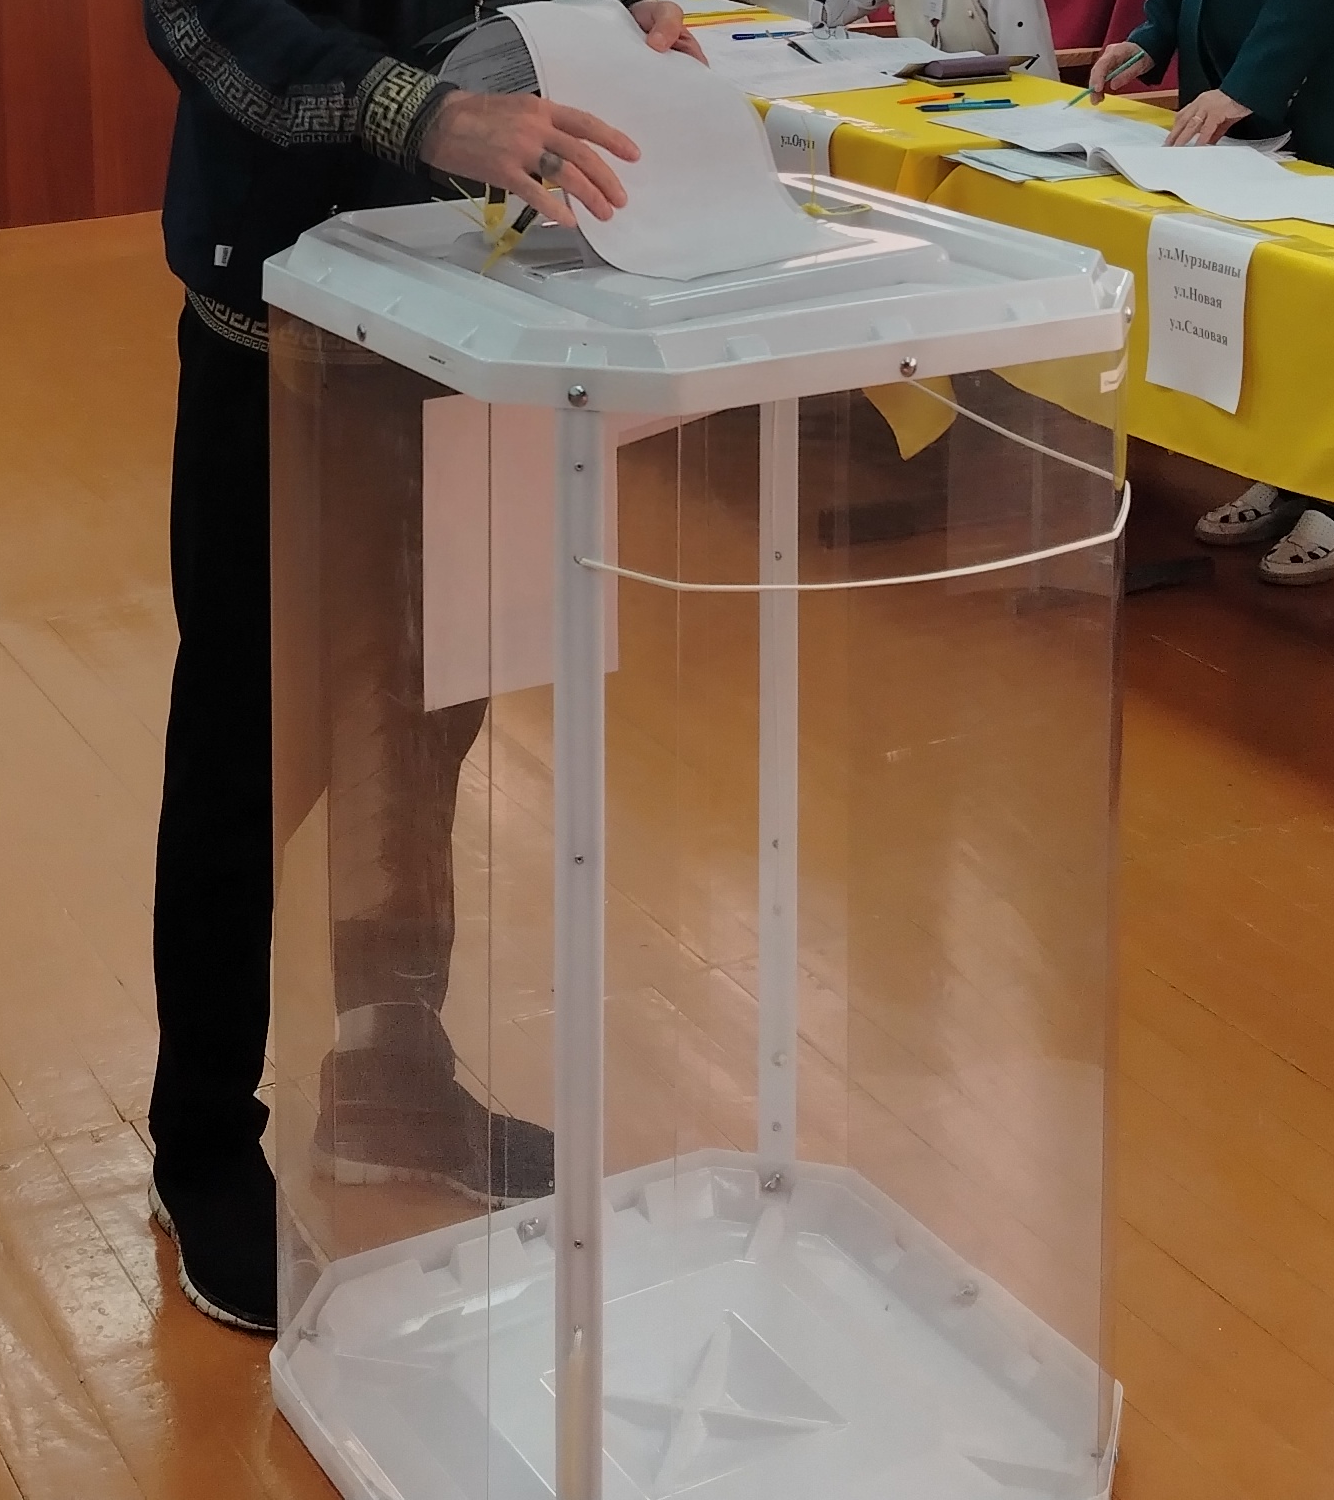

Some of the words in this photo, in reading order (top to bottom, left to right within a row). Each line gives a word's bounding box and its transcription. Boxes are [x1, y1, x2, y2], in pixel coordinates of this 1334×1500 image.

[1158, 247, 1241, 279] ул.Мурзываны
[1173, 285, 1223, 309] ул.Новая
[1169, 318, 1228, 347] ул.Садовая
